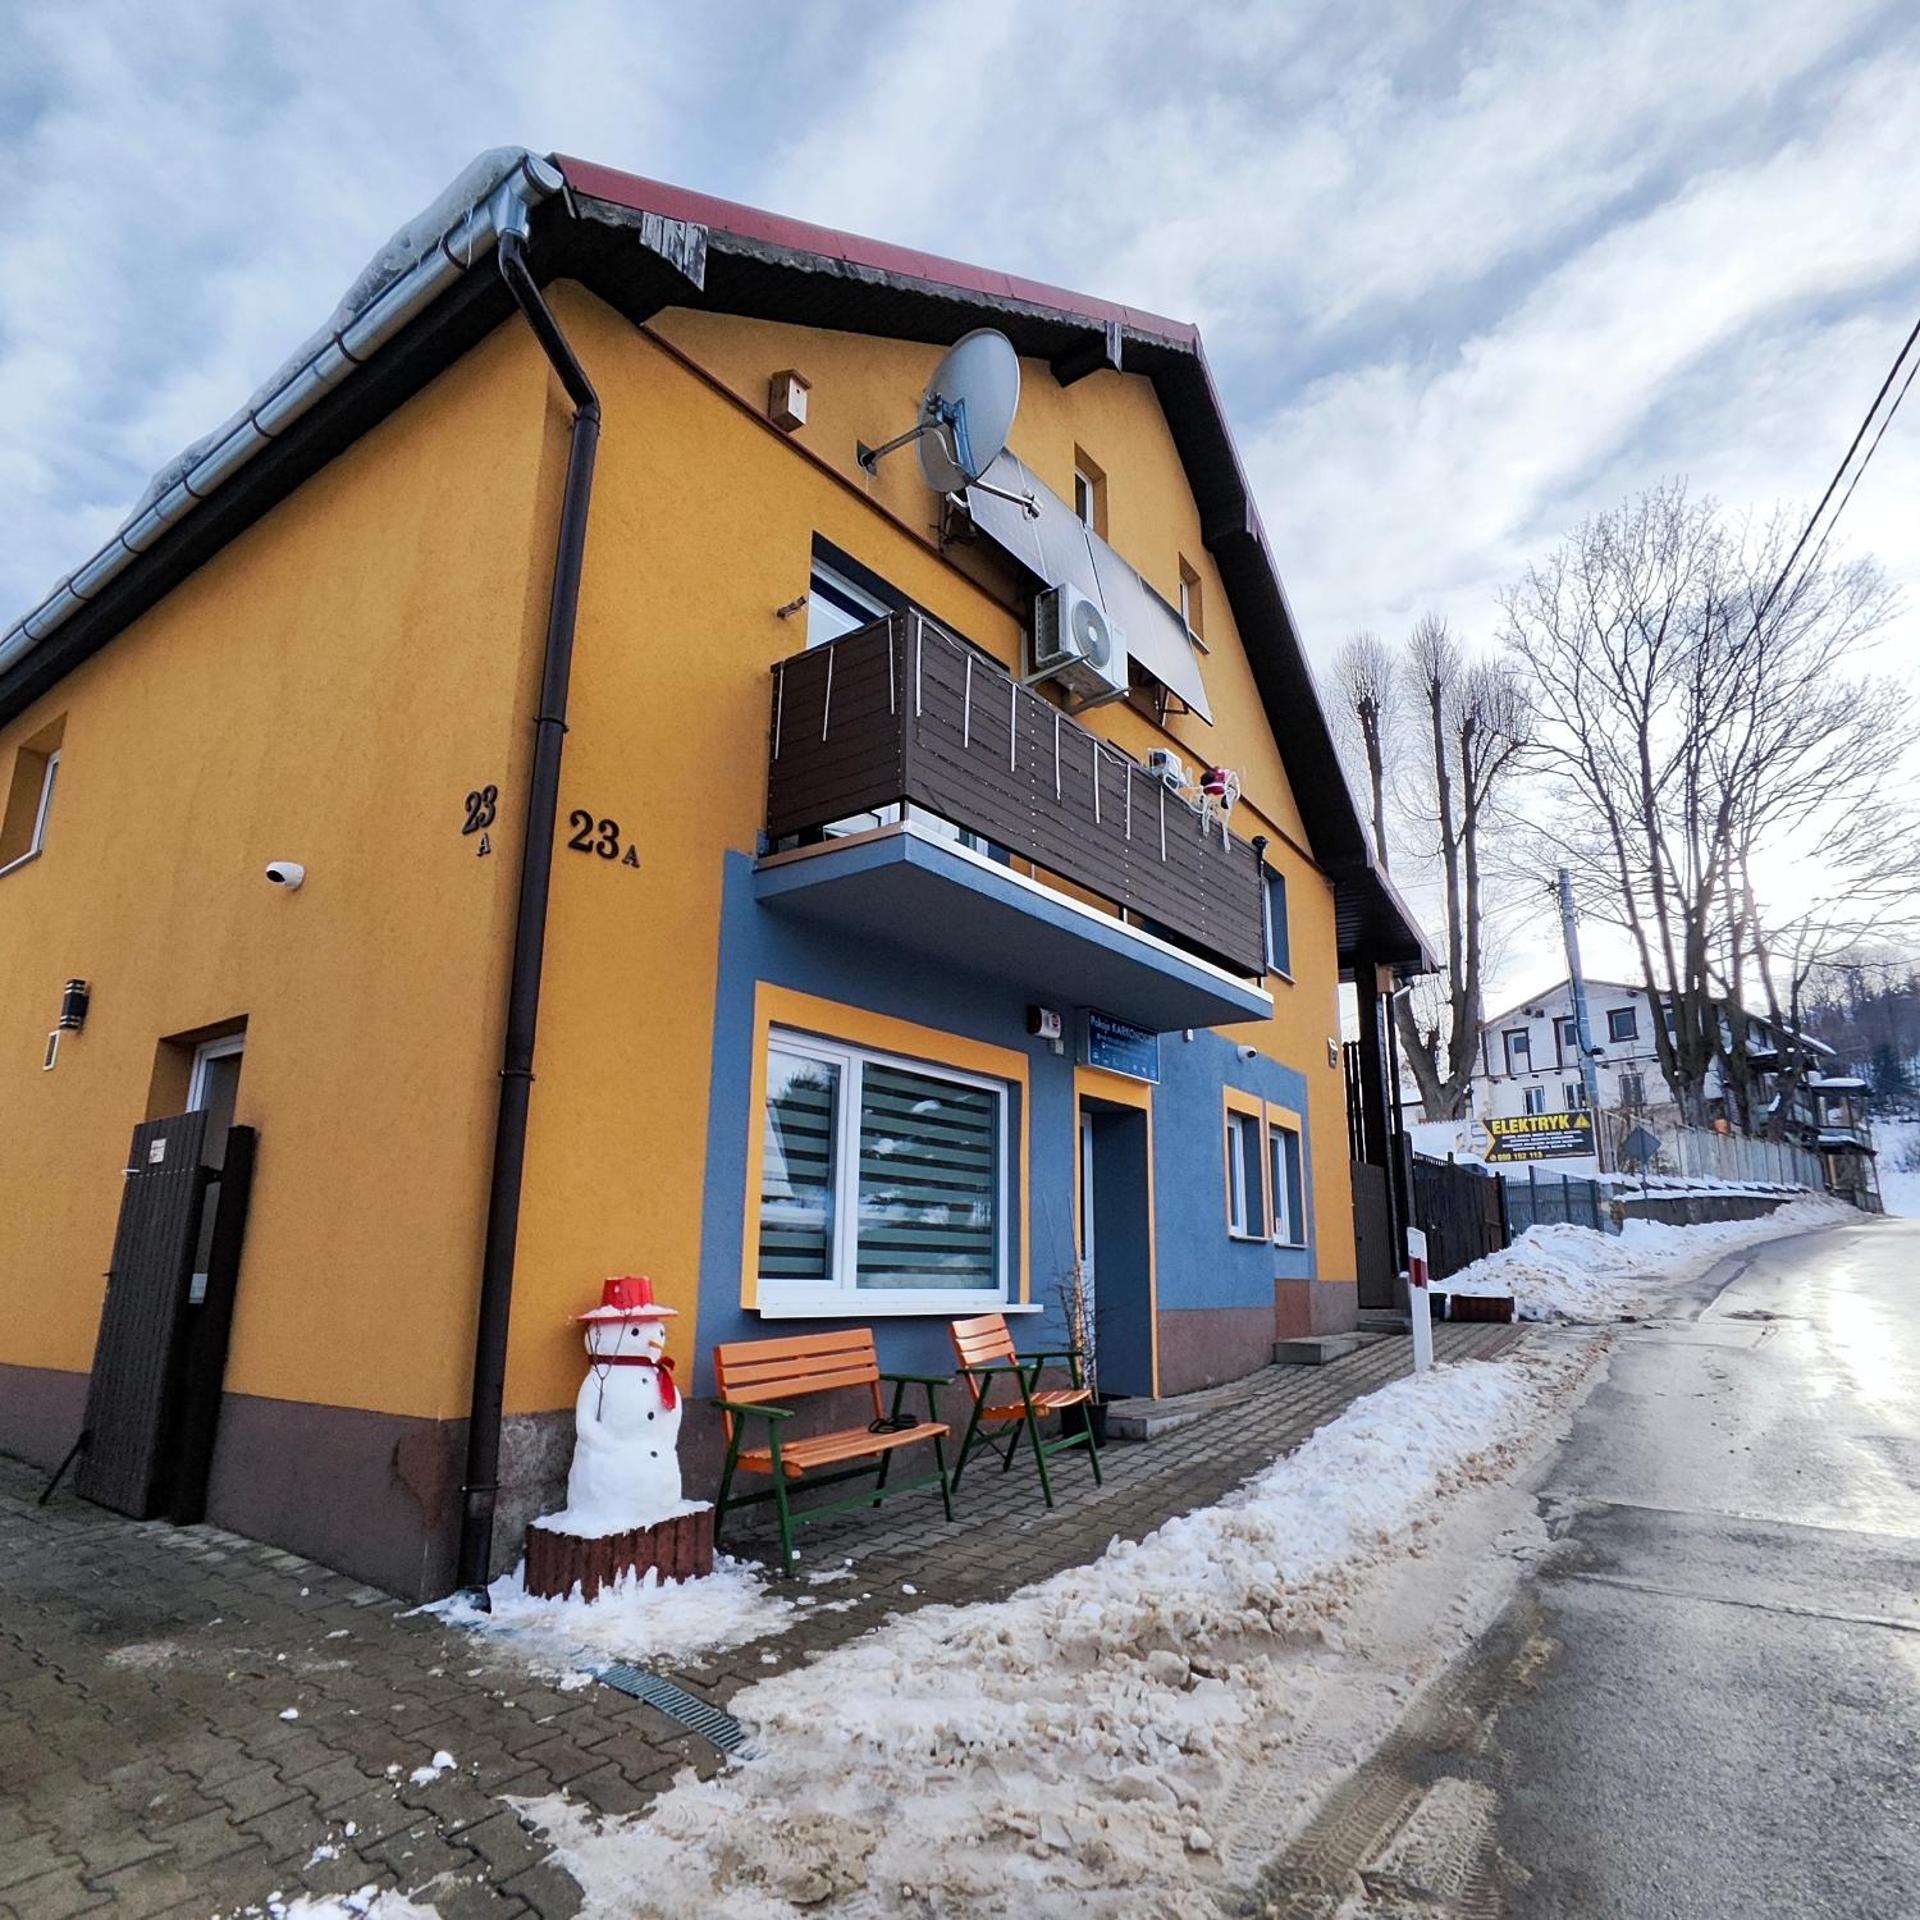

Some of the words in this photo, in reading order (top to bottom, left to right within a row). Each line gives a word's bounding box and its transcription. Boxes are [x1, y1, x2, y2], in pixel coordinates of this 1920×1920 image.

[462, 784, 498, 835] 23
[476, 832, 491, 857] A
[1491, 1114, 1570, 1135] ELEKTRYK
